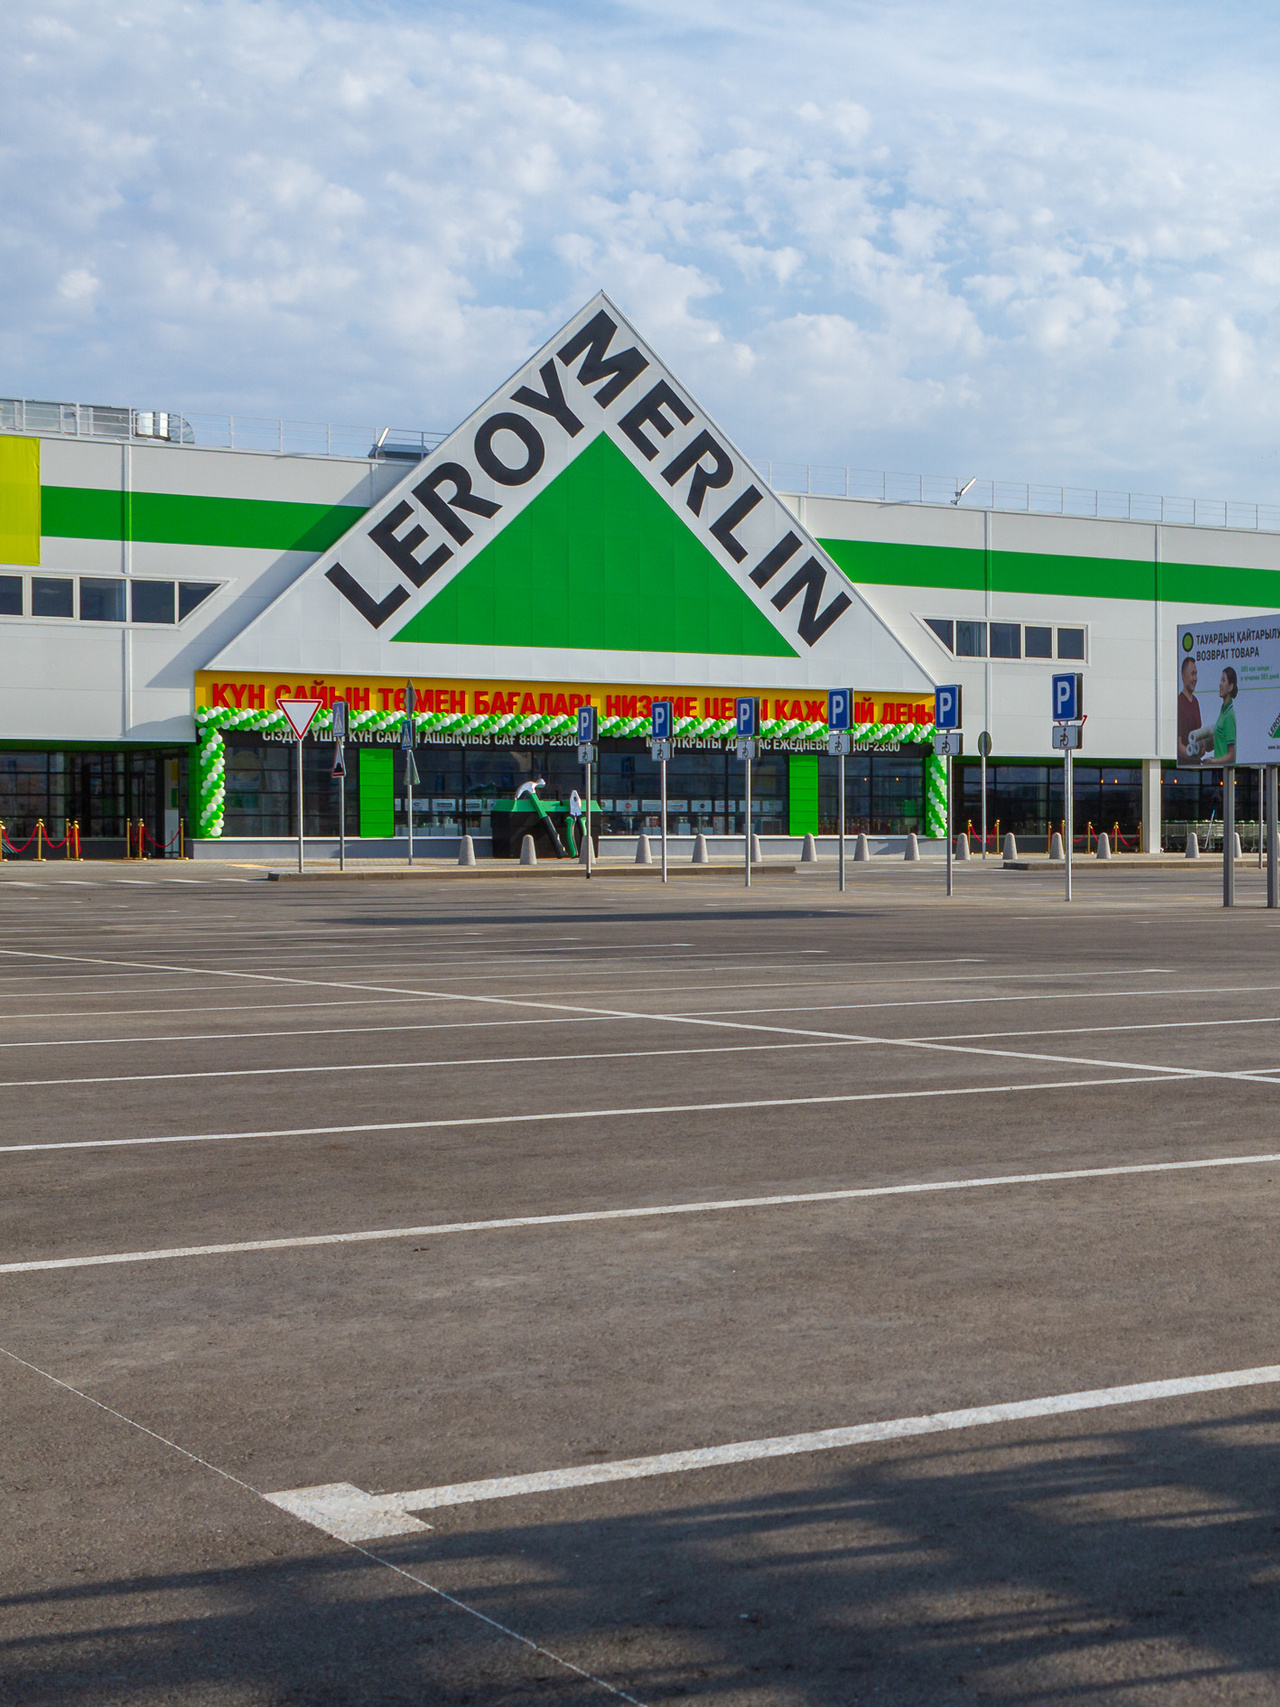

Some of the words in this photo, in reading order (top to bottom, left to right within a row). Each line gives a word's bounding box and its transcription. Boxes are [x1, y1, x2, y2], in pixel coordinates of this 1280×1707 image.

[324, 357, 585, 630] LEROY
[556, 308, 853, 648] MERLIN
[1196, 632, 1236, 646] ТАУАРДЫҢ
[1196, 649, 1230, 662] ВОЗВРАТ
[1231, 646, 1260, 660] ТОВАРА
[213, 683, 265, 710] КҮН
[606, 695, 698, 719] НИЗИЕ
[775, 697, 874, 724] КАЖЙ
[880, 702, 936, 725] ДЕНЬ
[832, 695, 844, 725] P
[939, 692, 952, 723] P
[1057, 681, 1071, 714] P
[580, 712, 589, 737] P
[655, 707, 665, 733] P
[740, 703, 750, 731] P
[773, 739, 829, 752] ЕЖЕДНЕВН
[854, 742, 901, 752] :00-23:00
